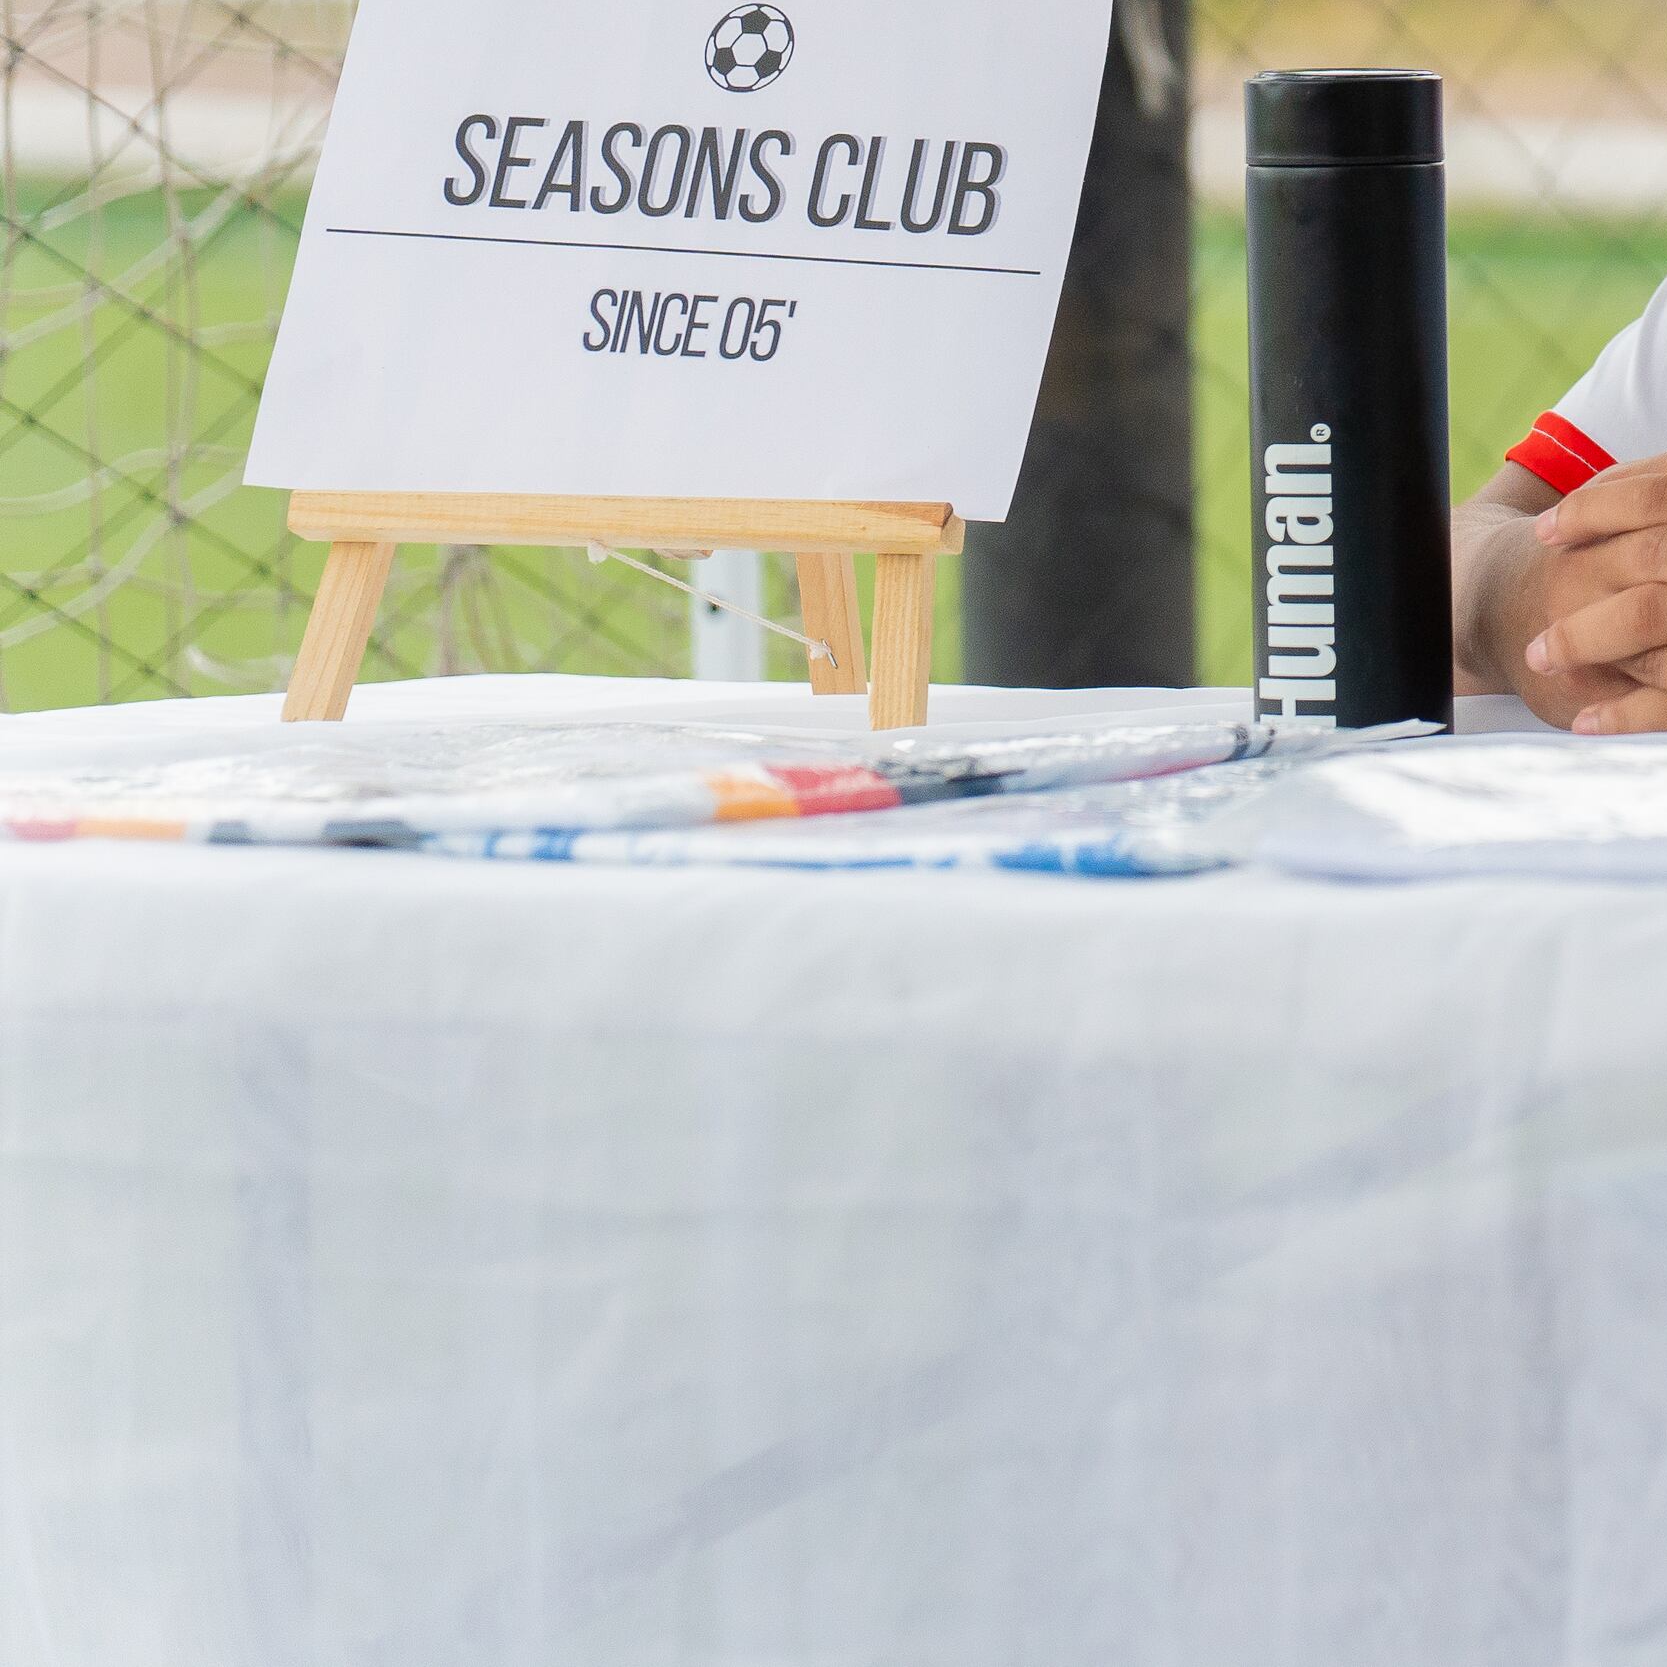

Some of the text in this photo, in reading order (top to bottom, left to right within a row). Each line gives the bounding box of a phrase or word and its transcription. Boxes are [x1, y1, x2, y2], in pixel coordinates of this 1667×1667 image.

[445, 114, 1009, 237] SEASONS CLUB
[583, 288, 718, 359] SINCE
